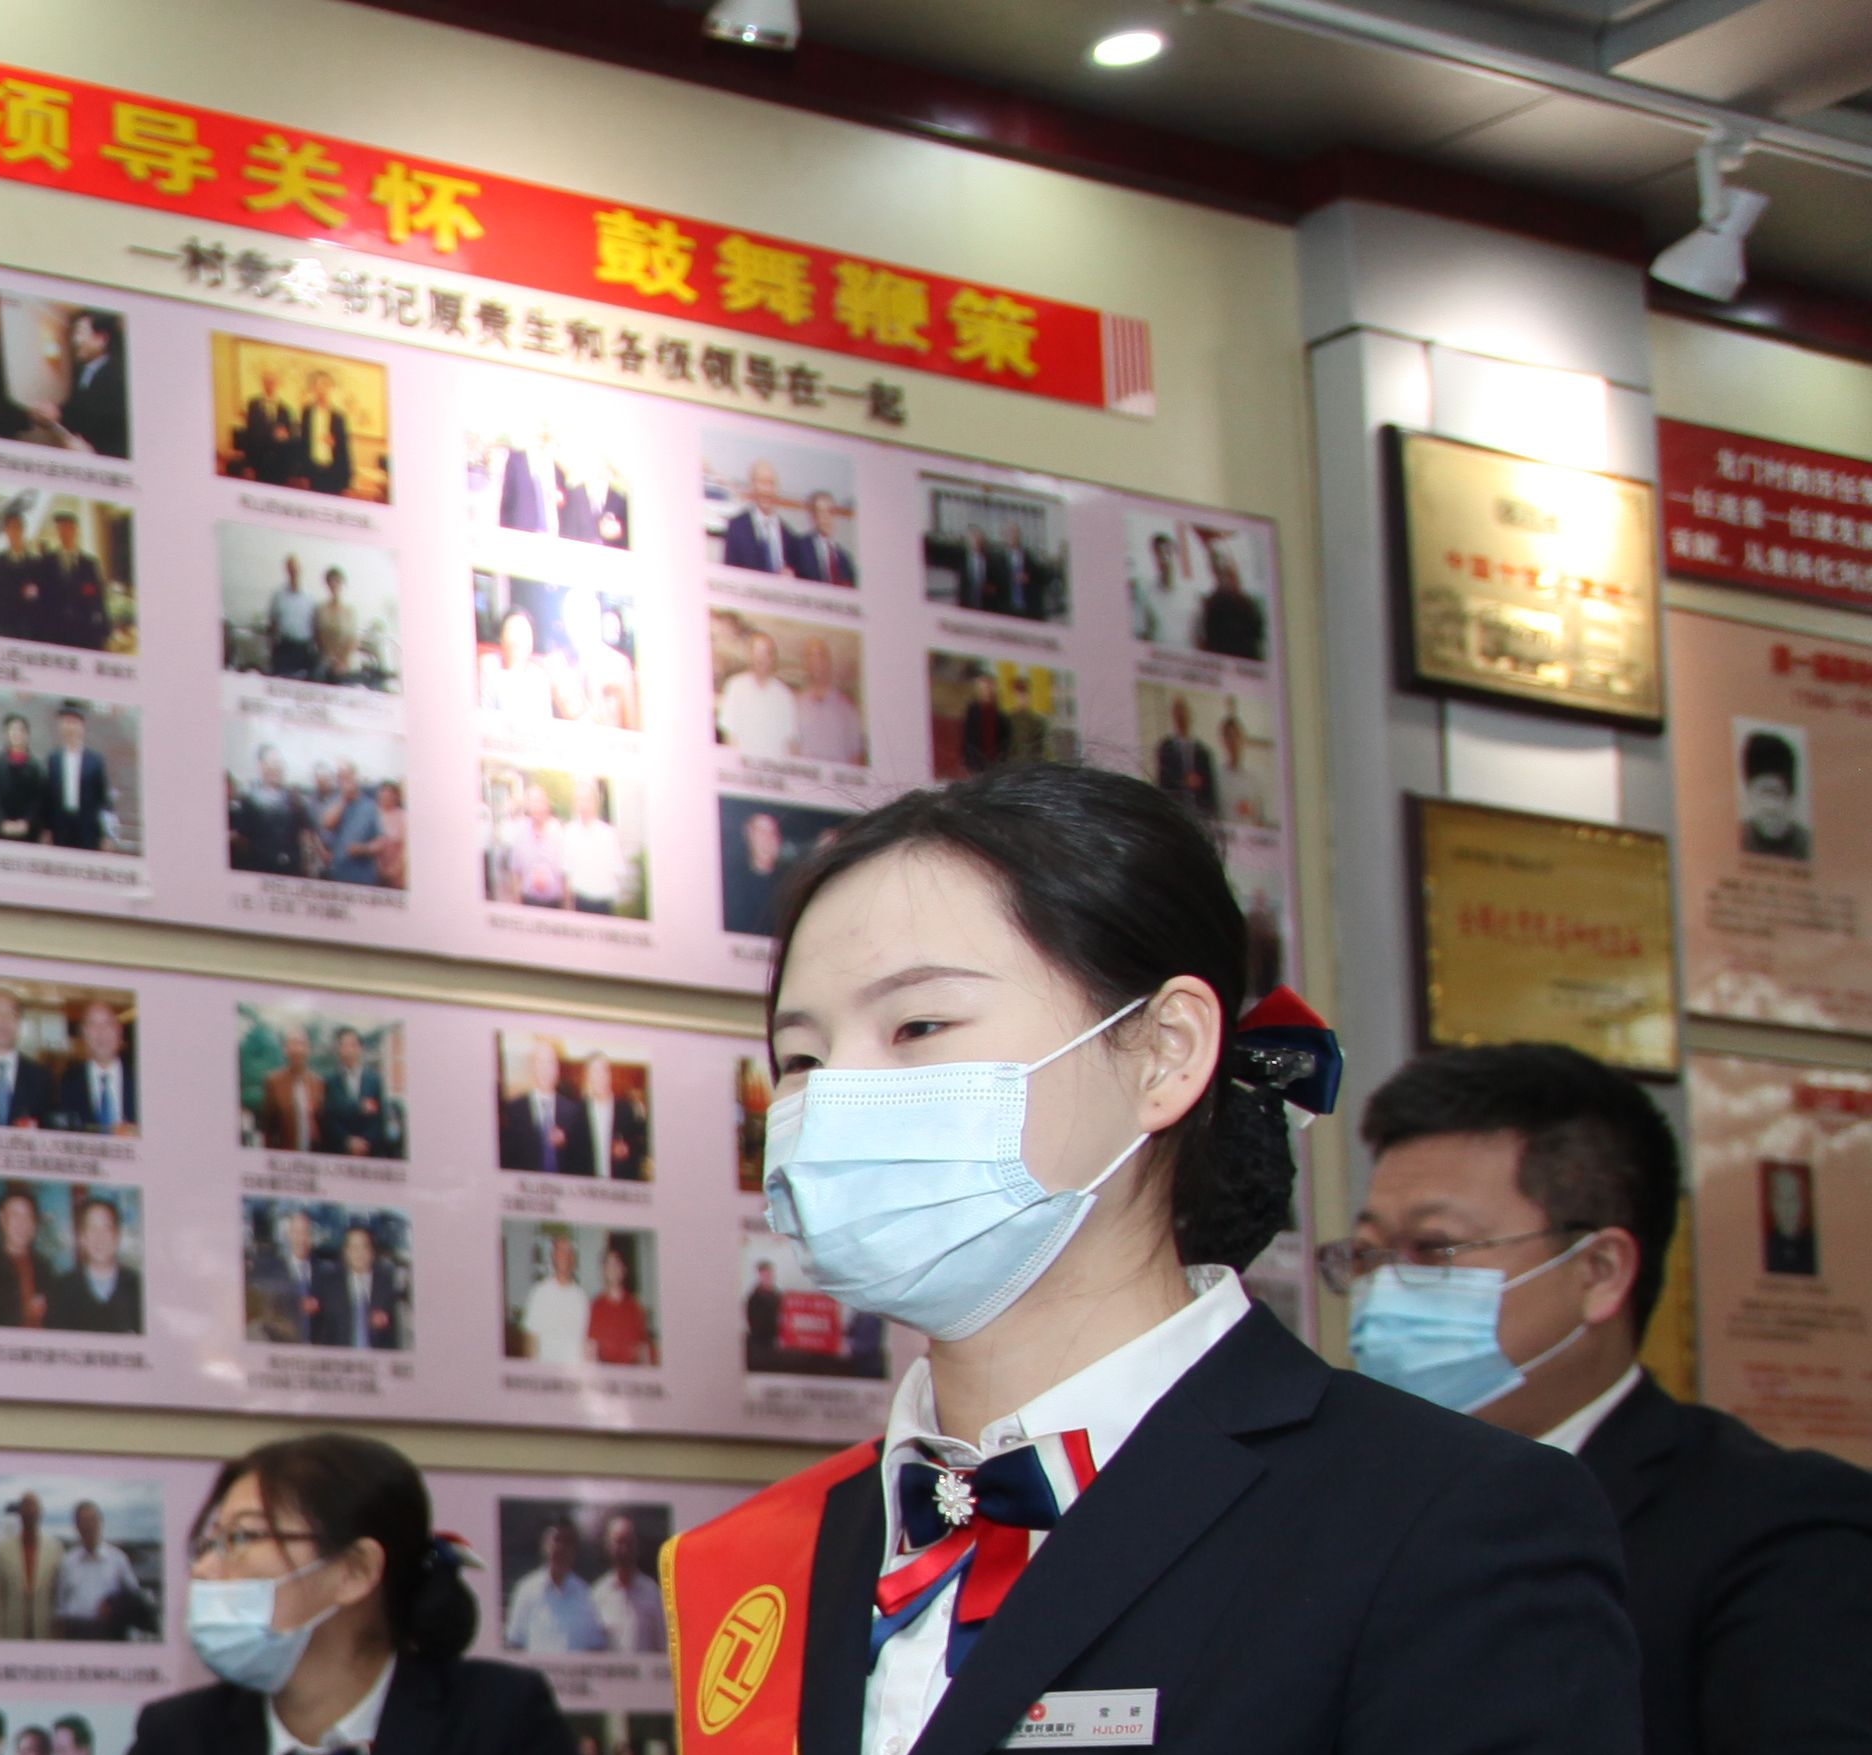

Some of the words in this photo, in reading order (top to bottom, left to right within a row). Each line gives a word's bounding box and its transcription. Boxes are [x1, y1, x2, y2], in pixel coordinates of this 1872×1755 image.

[593, 206, 1042, 380] 鼓舞鞭策
[1092, 1724, 1143, 1735] HJLD107
